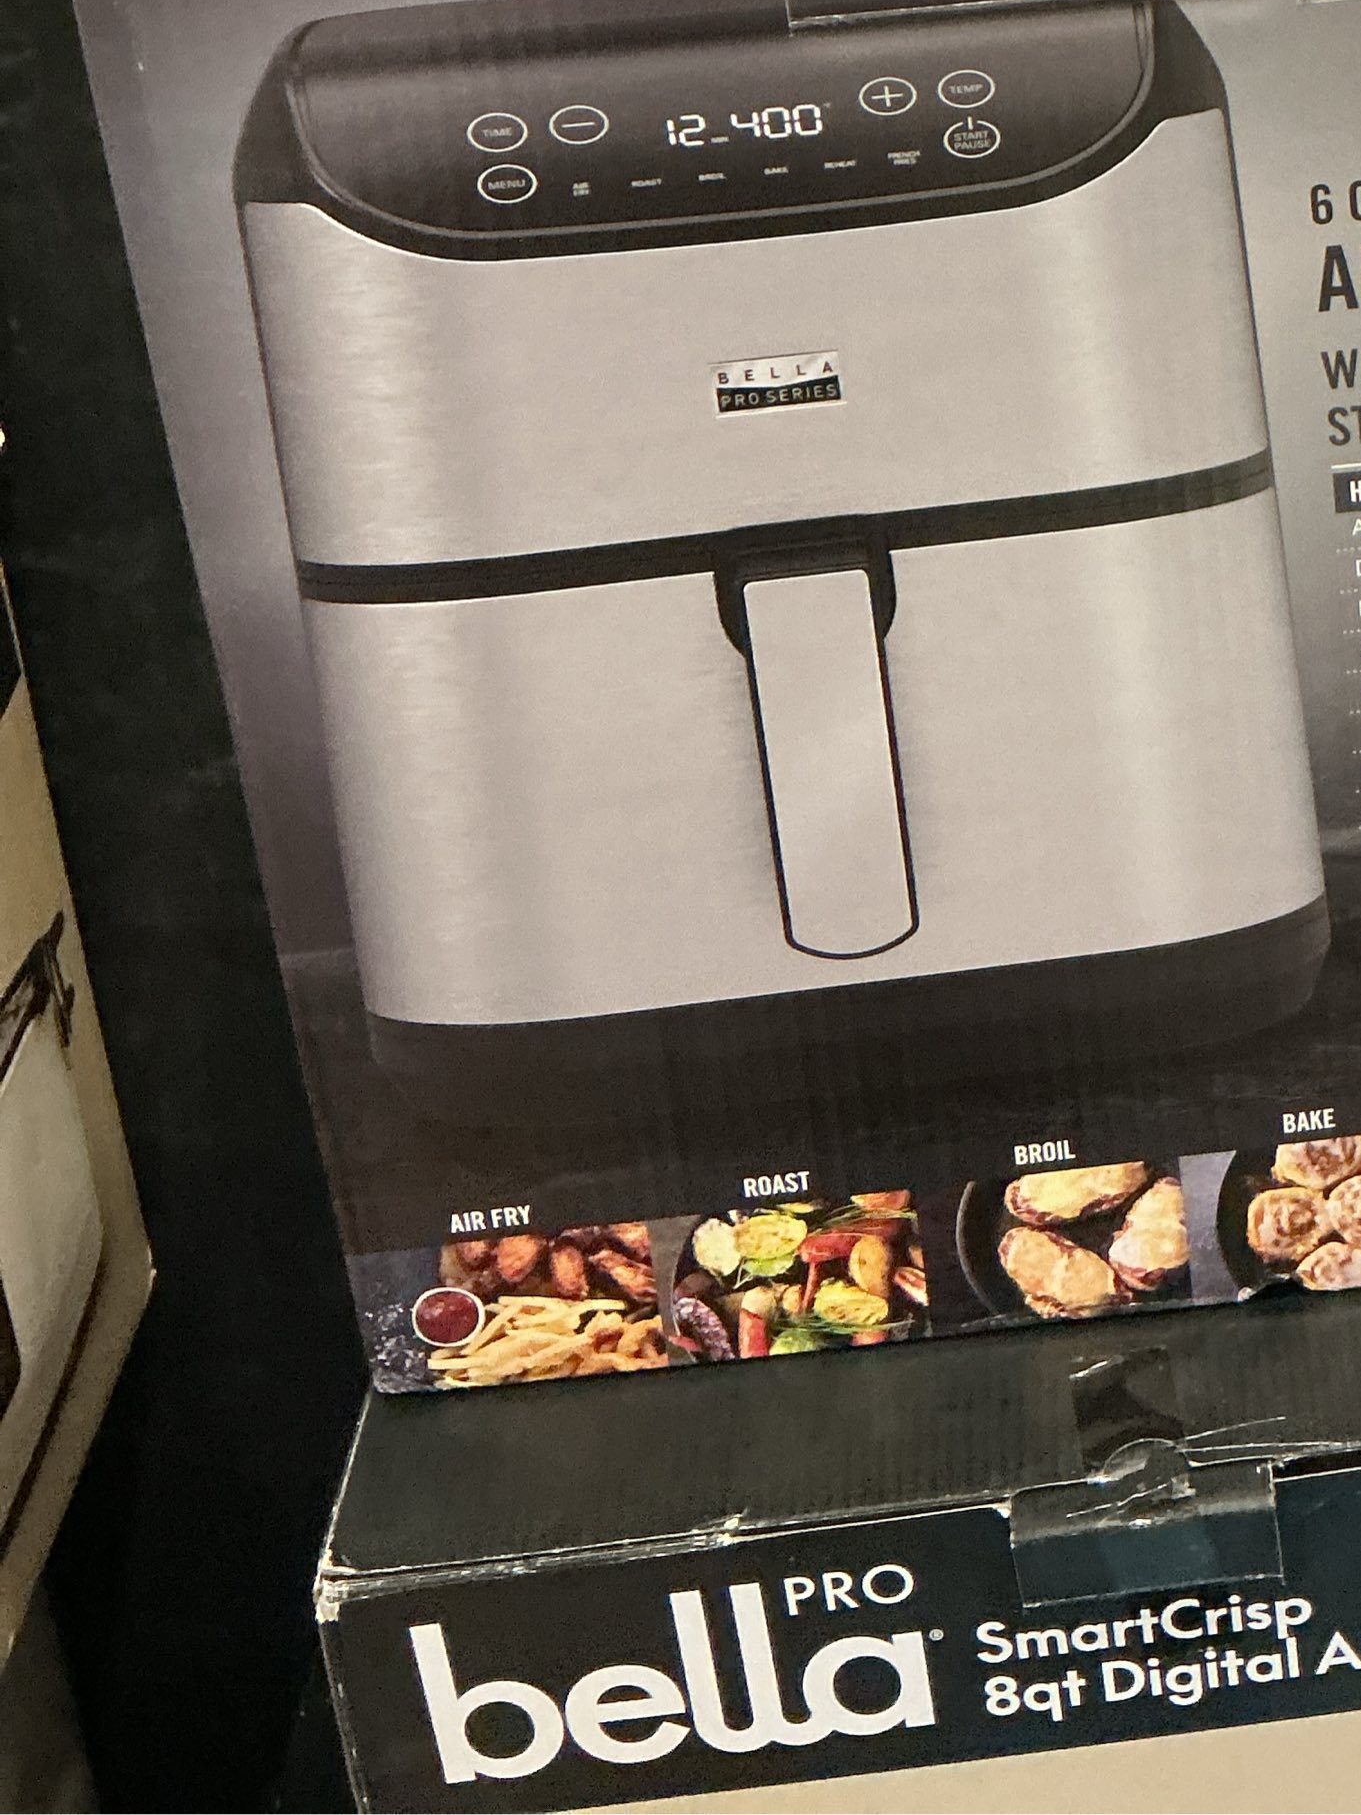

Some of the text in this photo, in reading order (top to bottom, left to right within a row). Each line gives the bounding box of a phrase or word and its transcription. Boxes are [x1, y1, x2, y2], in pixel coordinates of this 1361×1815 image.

[950, 84, 983, 94] TEMP
[483, 127, 512, 137] TIME
[666, 104, 823, 146] 12 400
[954, 131, 988, 141] START
[954, 140, 991, 150] PAUSE
[488, 180, 526, 190] MENU
[1310, 183, 1332, 224] 6
[718, 361, 833, 384] BELLA
[720, 384, 838, 408] PRO SERIES
[1282, 1107, 1336, 1134] BAKE
[1013, 1140, 1076, 1167] BROIL
[743, 1170, 811, 1199] ROAST
[450, 1204, 532, 1234] AIR FRY
[785, 1564, 915, 1616] PRO
[977, 1594, 1313, 1665] SmartCrisp
[984, 1672, 1085, 1724] 8qt
[1102, 1633, 1301, 1706] Digital
